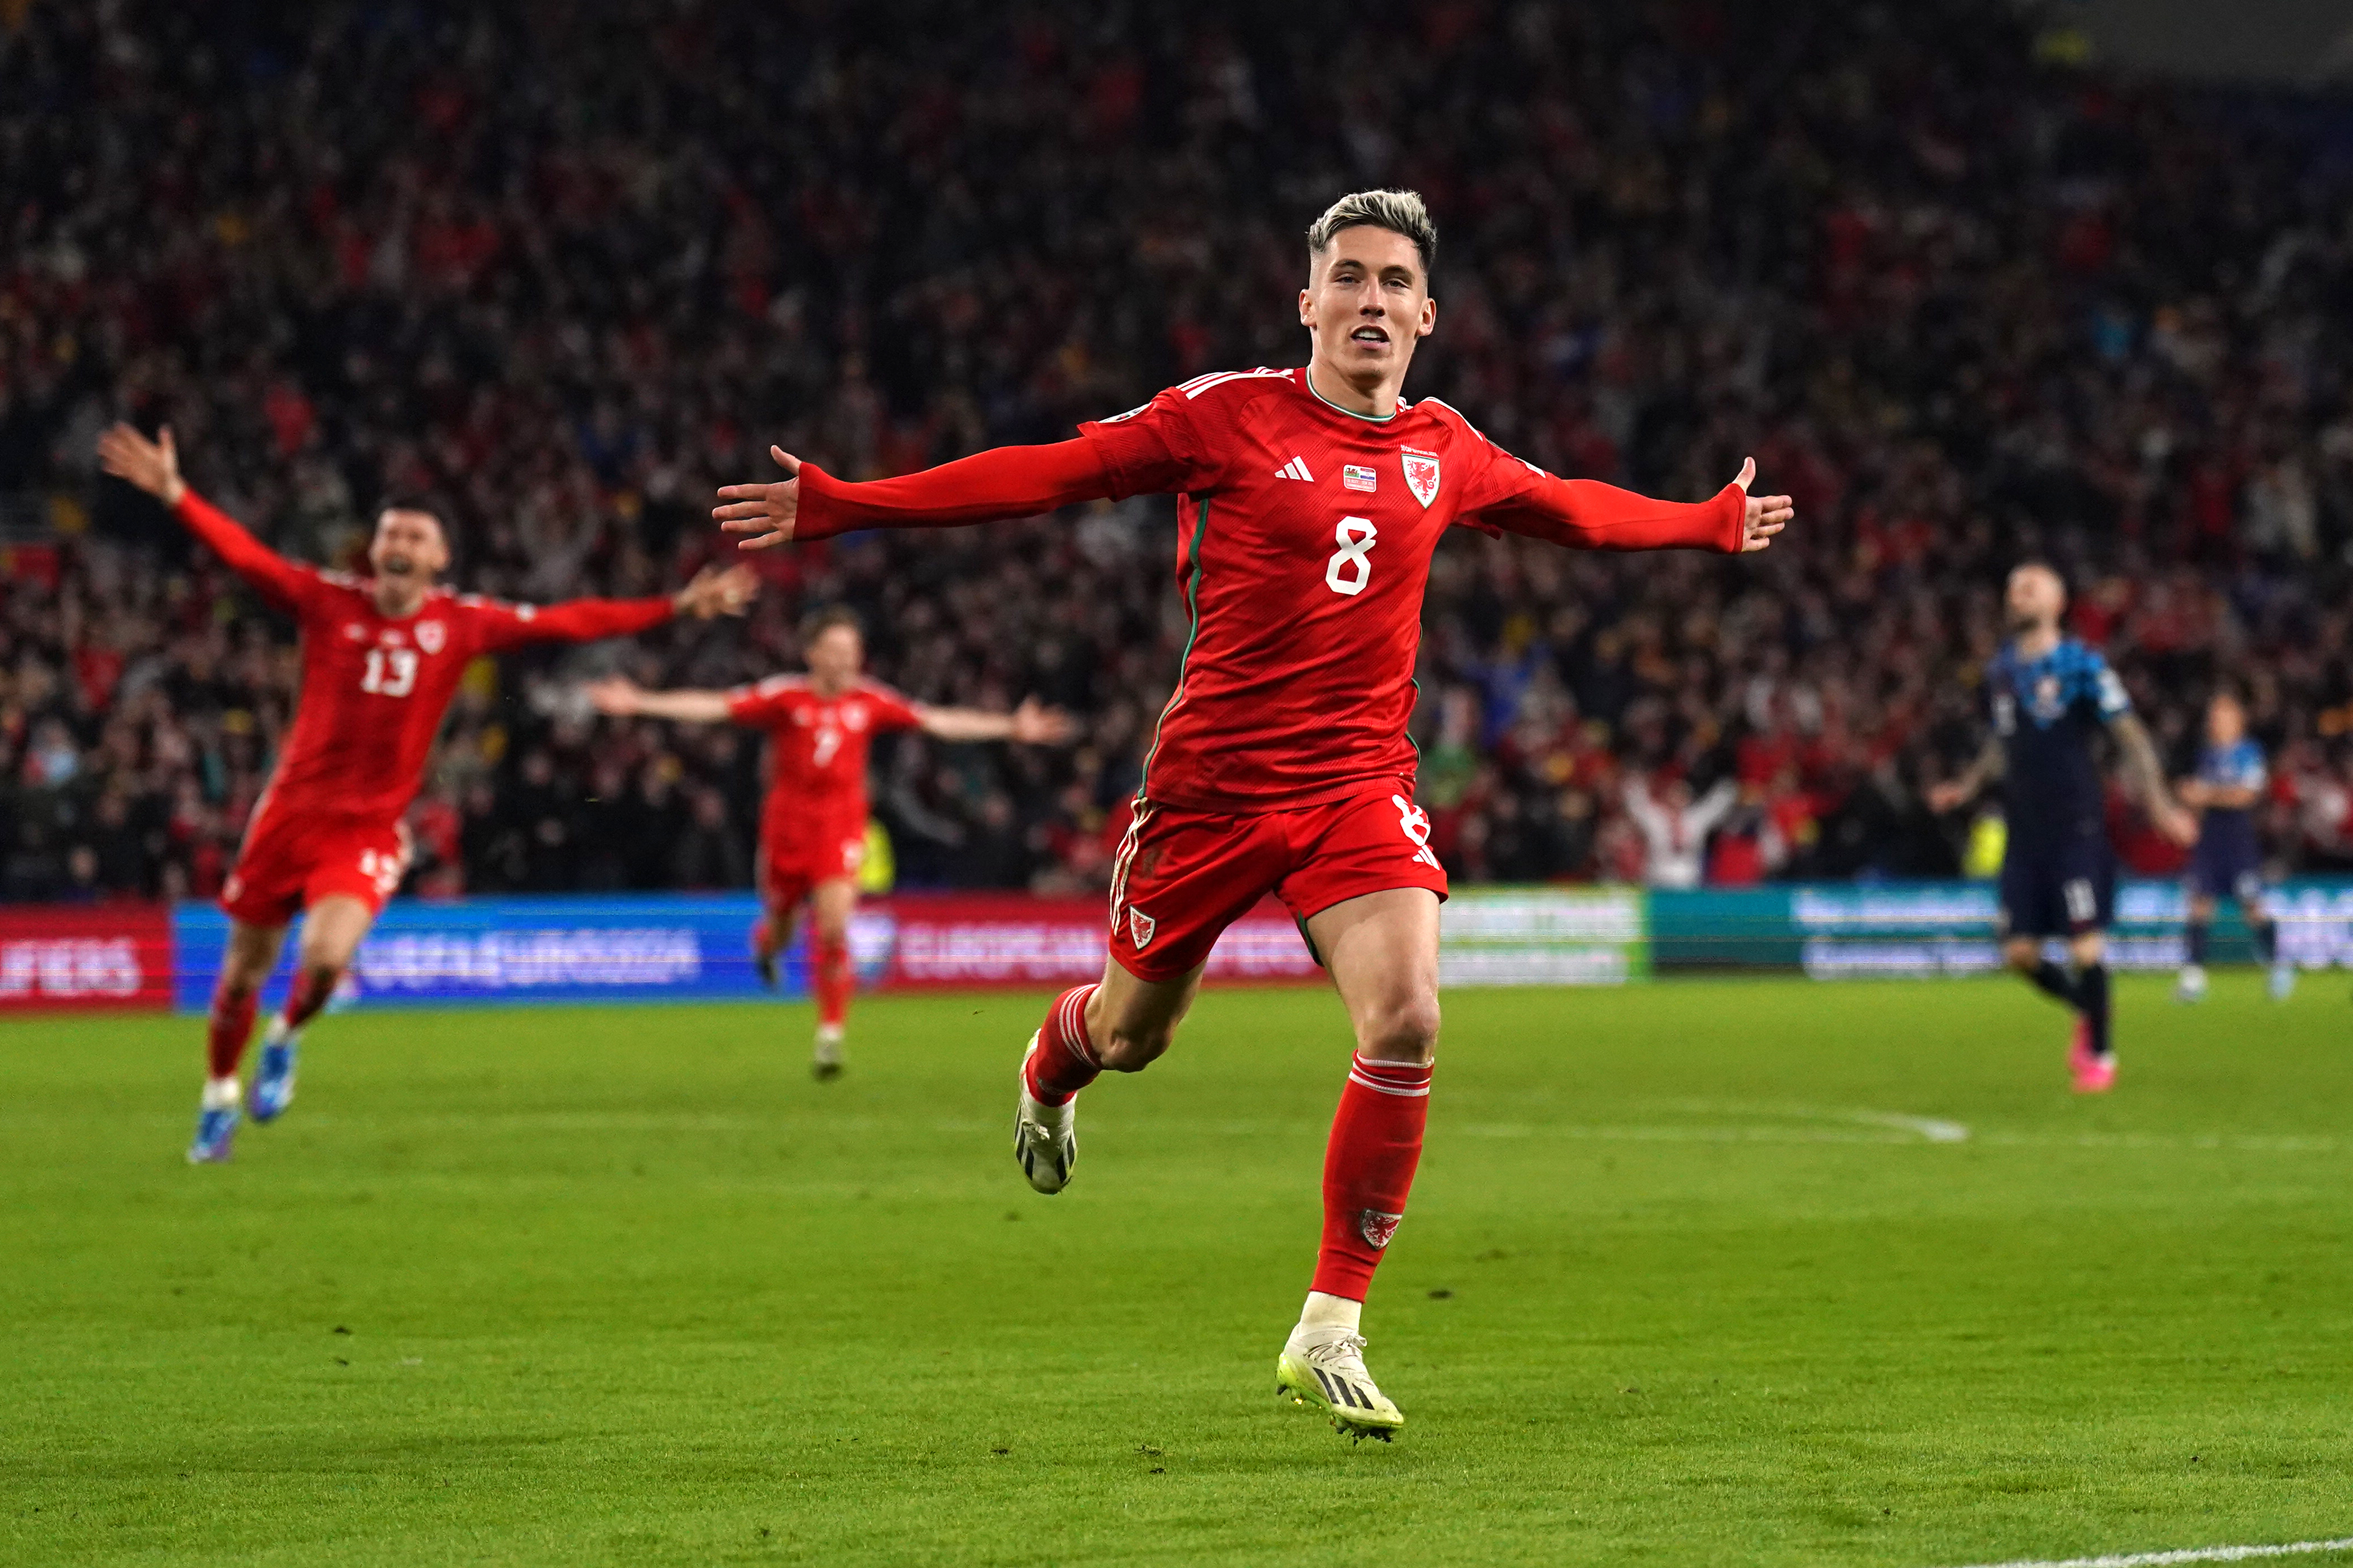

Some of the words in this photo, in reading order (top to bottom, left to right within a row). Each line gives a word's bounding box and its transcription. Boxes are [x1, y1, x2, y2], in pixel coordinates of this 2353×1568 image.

[1326, 516, 1378, 596] 8
[360, 648, 419, 698] 13
[814, 727, 842, 769] 7
[1391, 794, 1431, 847] 8
